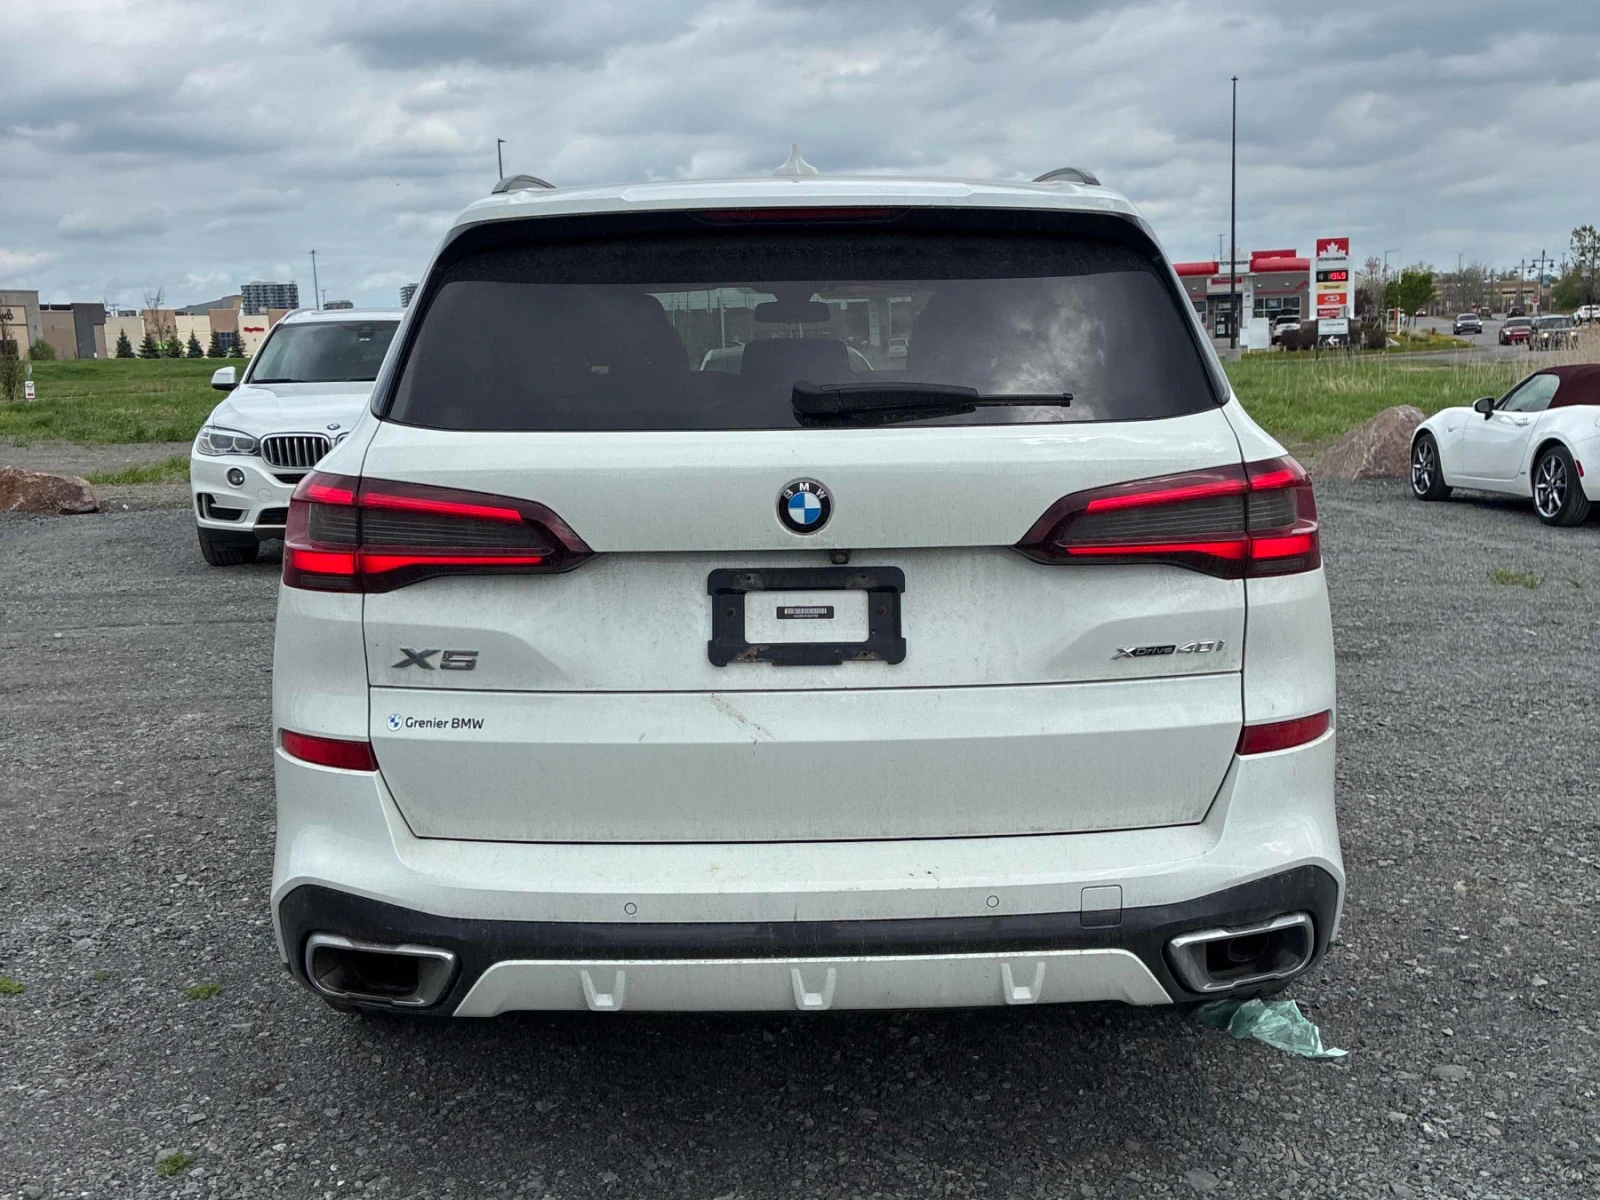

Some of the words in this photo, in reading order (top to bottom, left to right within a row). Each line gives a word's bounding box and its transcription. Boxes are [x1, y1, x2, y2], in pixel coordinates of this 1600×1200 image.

[783, 482, 827, 500] BMW
[1176, 640, 1225, 654] 40i
[391, 648, 479, 670] X5
[405, 717, 449, 729] Grenier
[451, 718, 484, 729] BMW
